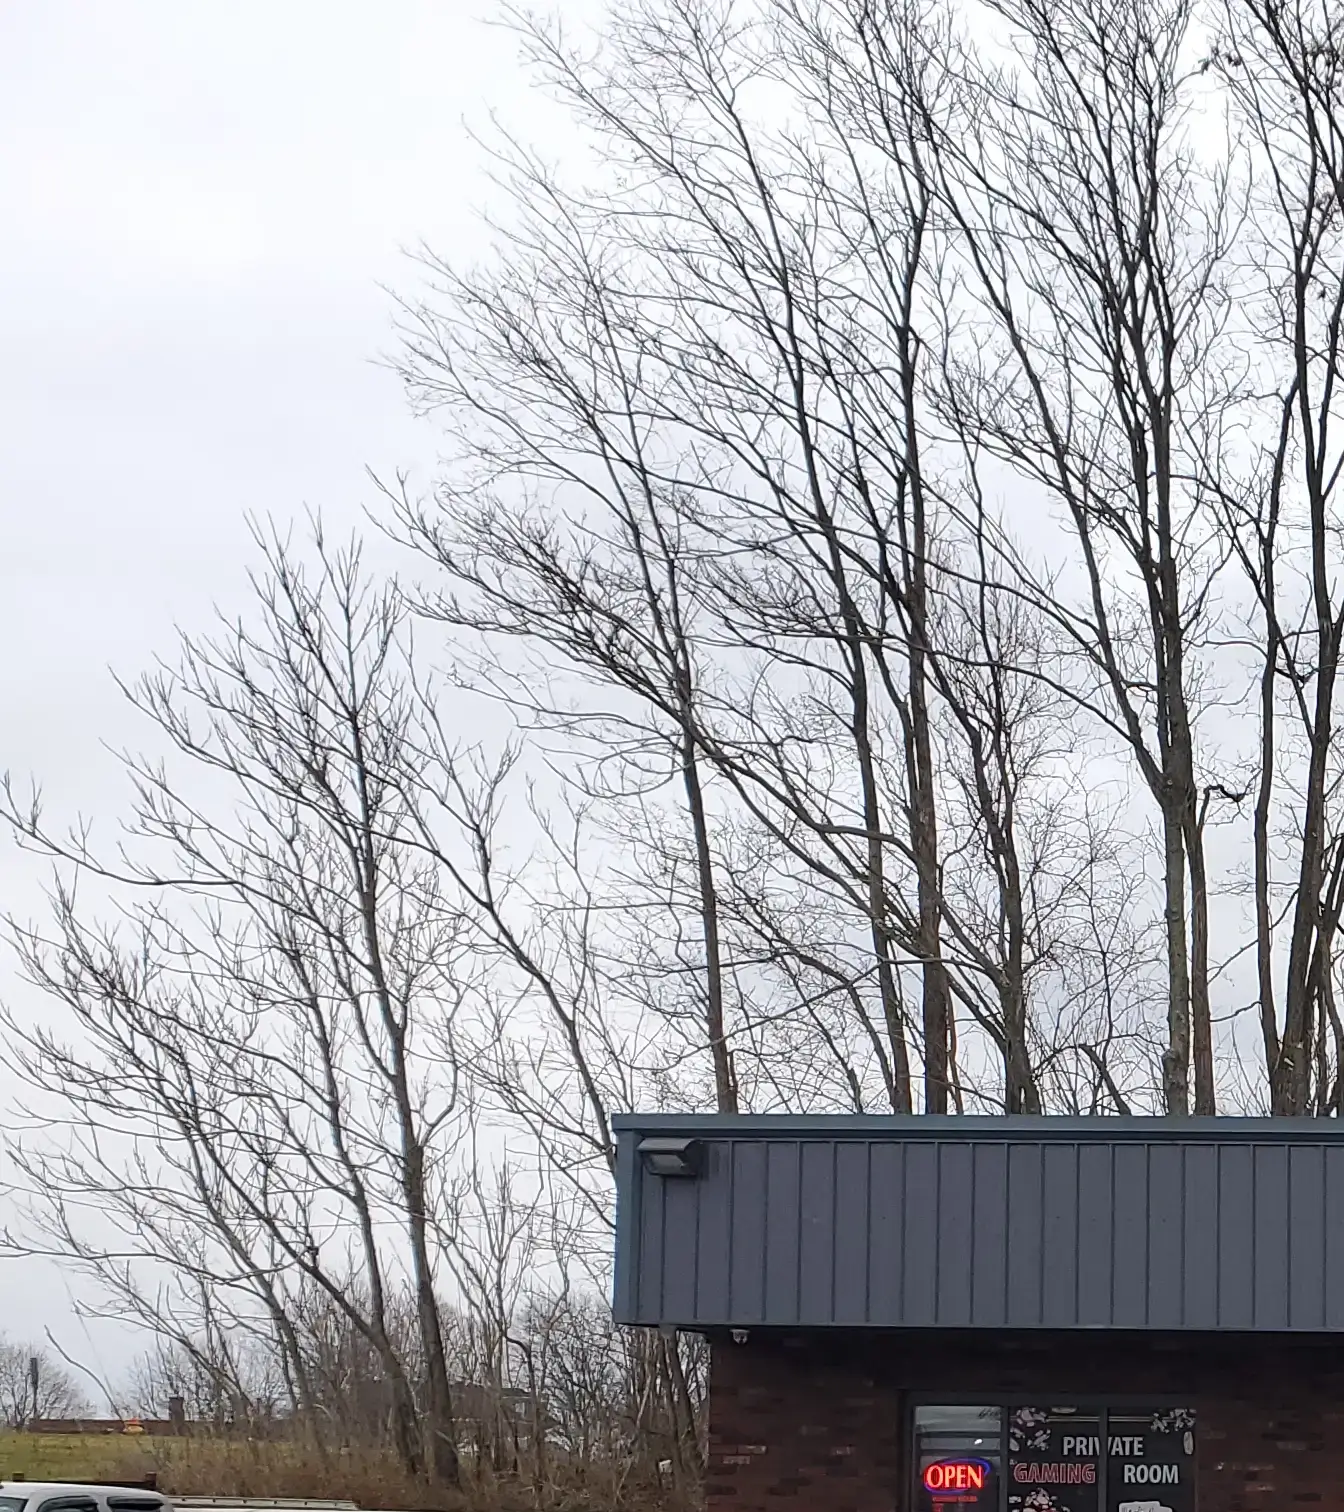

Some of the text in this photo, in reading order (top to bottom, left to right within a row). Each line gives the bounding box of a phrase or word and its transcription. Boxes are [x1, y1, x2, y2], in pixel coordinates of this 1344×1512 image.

[1062, 1436, 1144, 1456] PRIVATE
[926, 1464, 983, 1489] OPEN
[1013, 1463, 1179, 1484] GAMING ROOM
